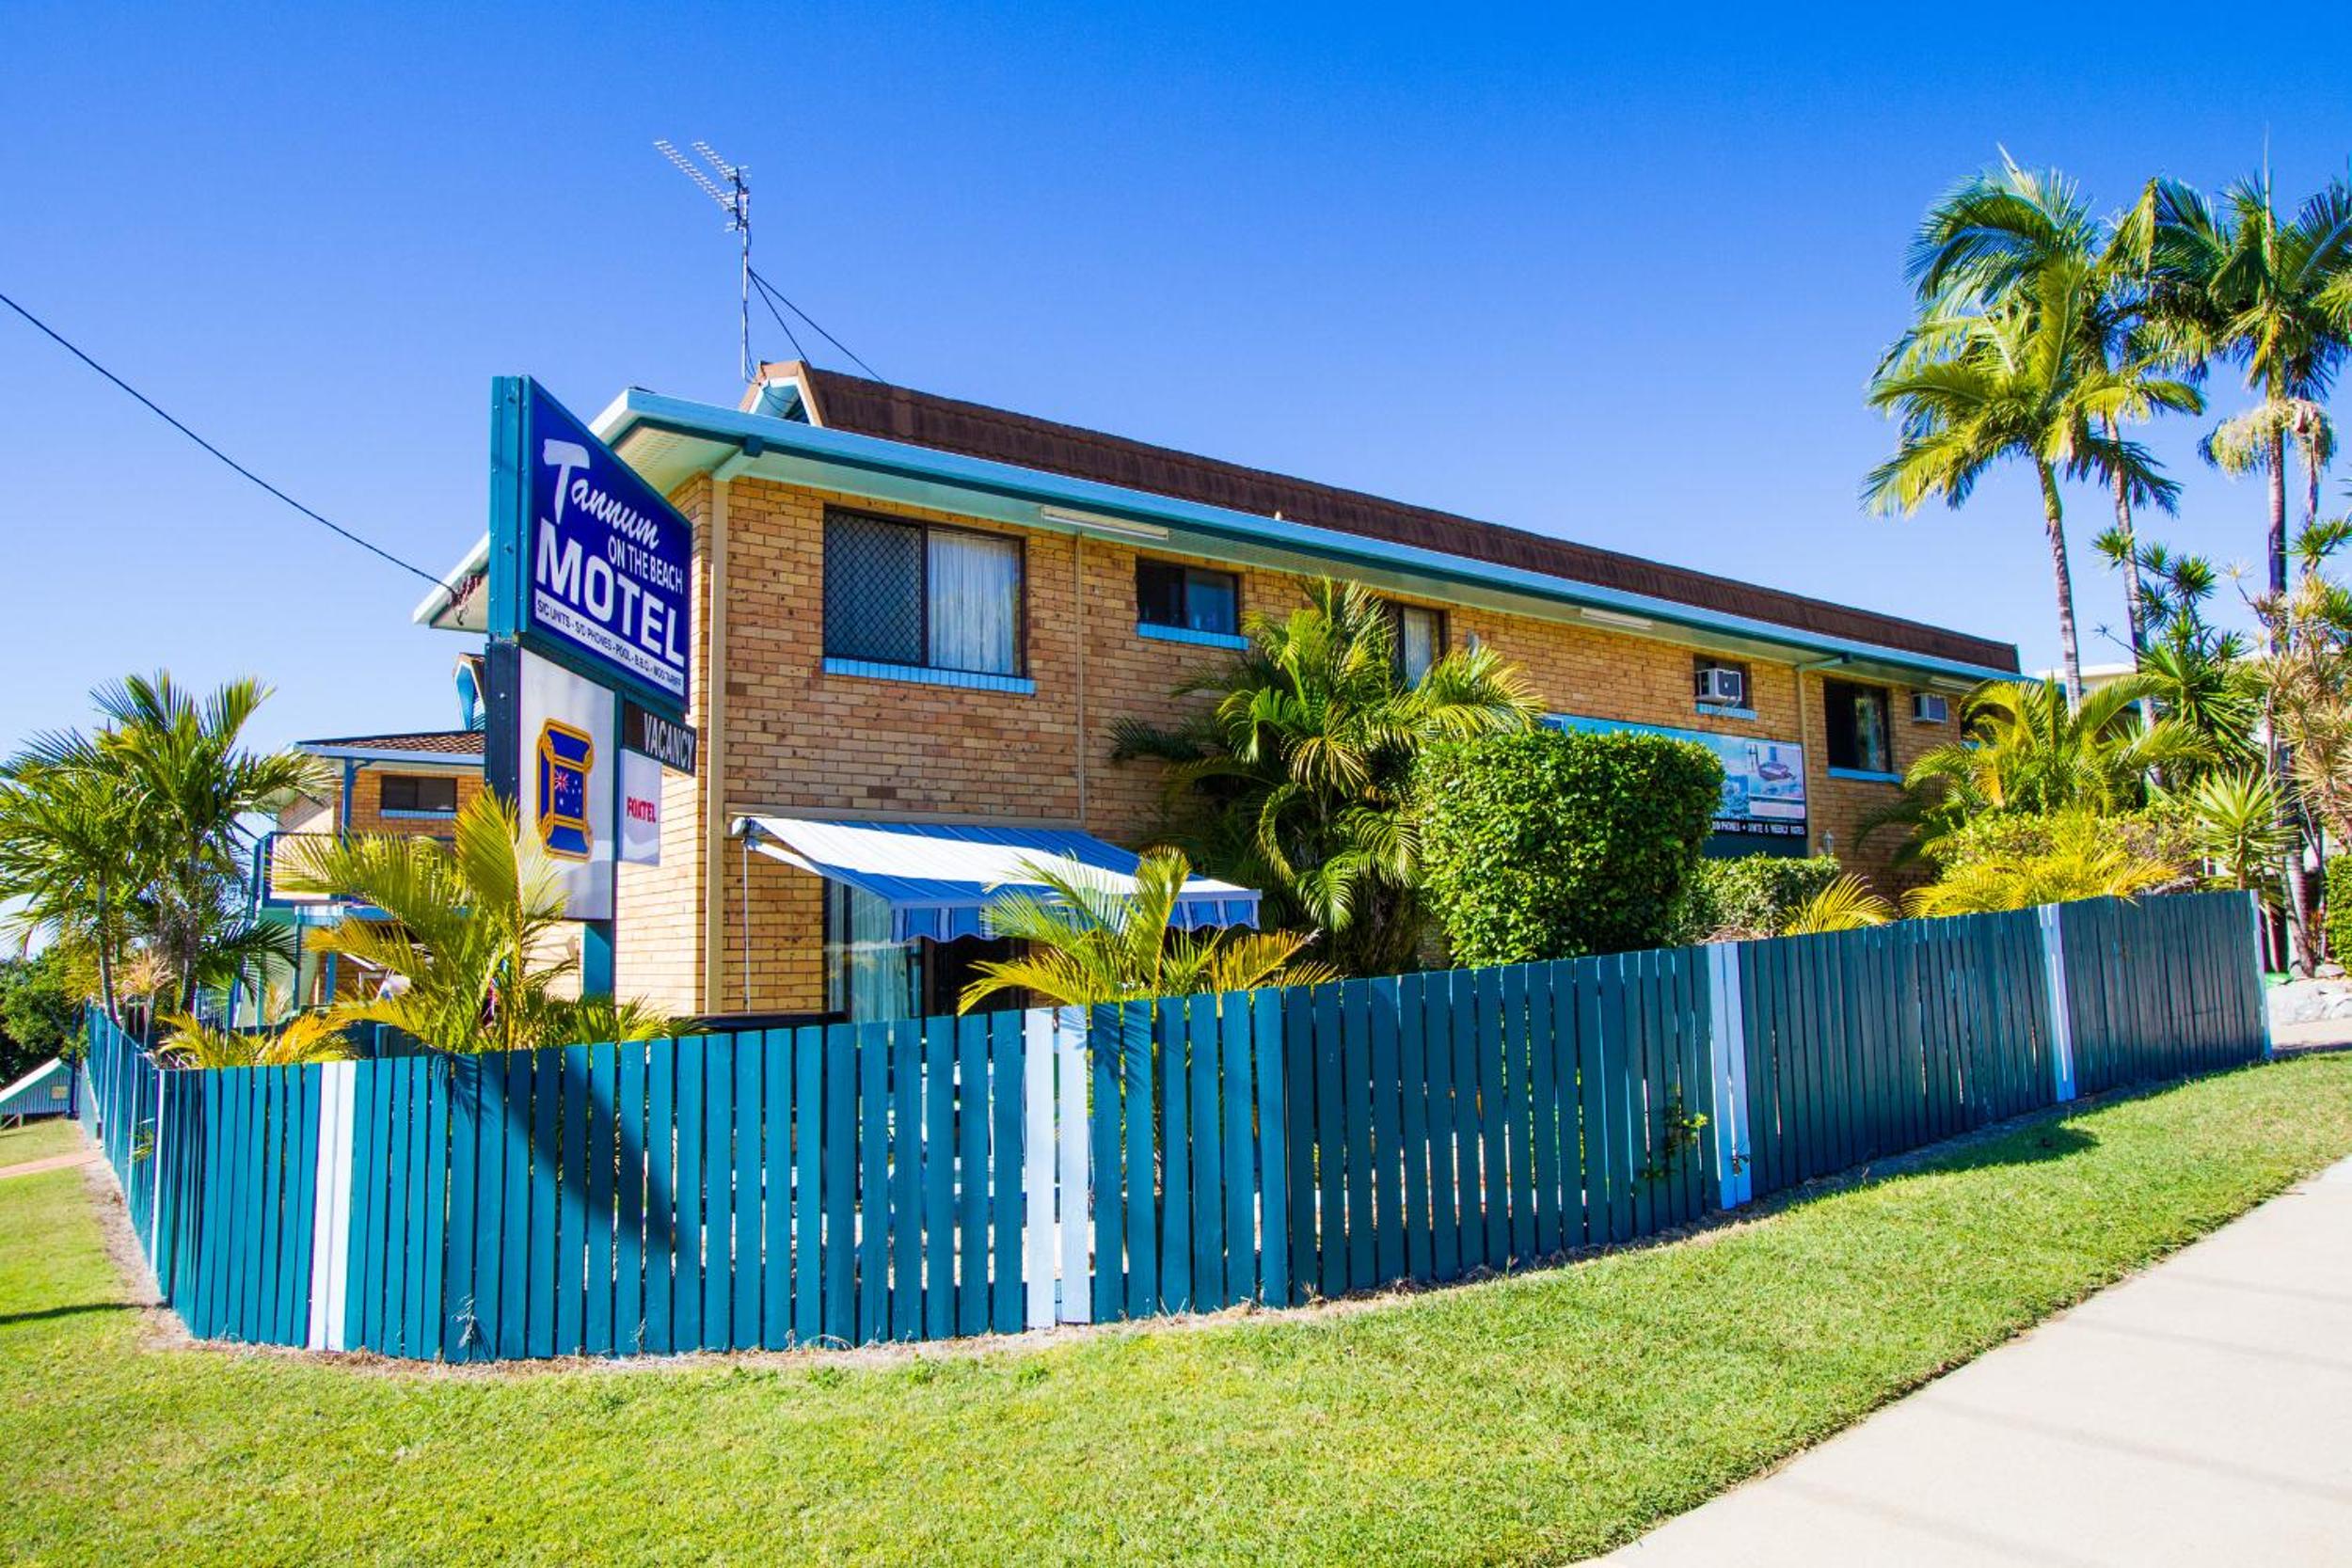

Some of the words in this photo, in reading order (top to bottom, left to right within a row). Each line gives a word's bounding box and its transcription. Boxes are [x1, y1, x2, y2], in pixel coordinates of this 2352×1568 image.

[543, 438, 659, 550] Tannum
[536, 516, 684, 668] MOTEL
[608, 535, 626, 569] ON
[628, 544, 648, 580] THE
[650, 555, 683, 594] BEACH
[550, 607, 570, 628] UNITS
[644, 712, 694, 770] VACANCY
[627, 796, 657, 824] FOXTEL
